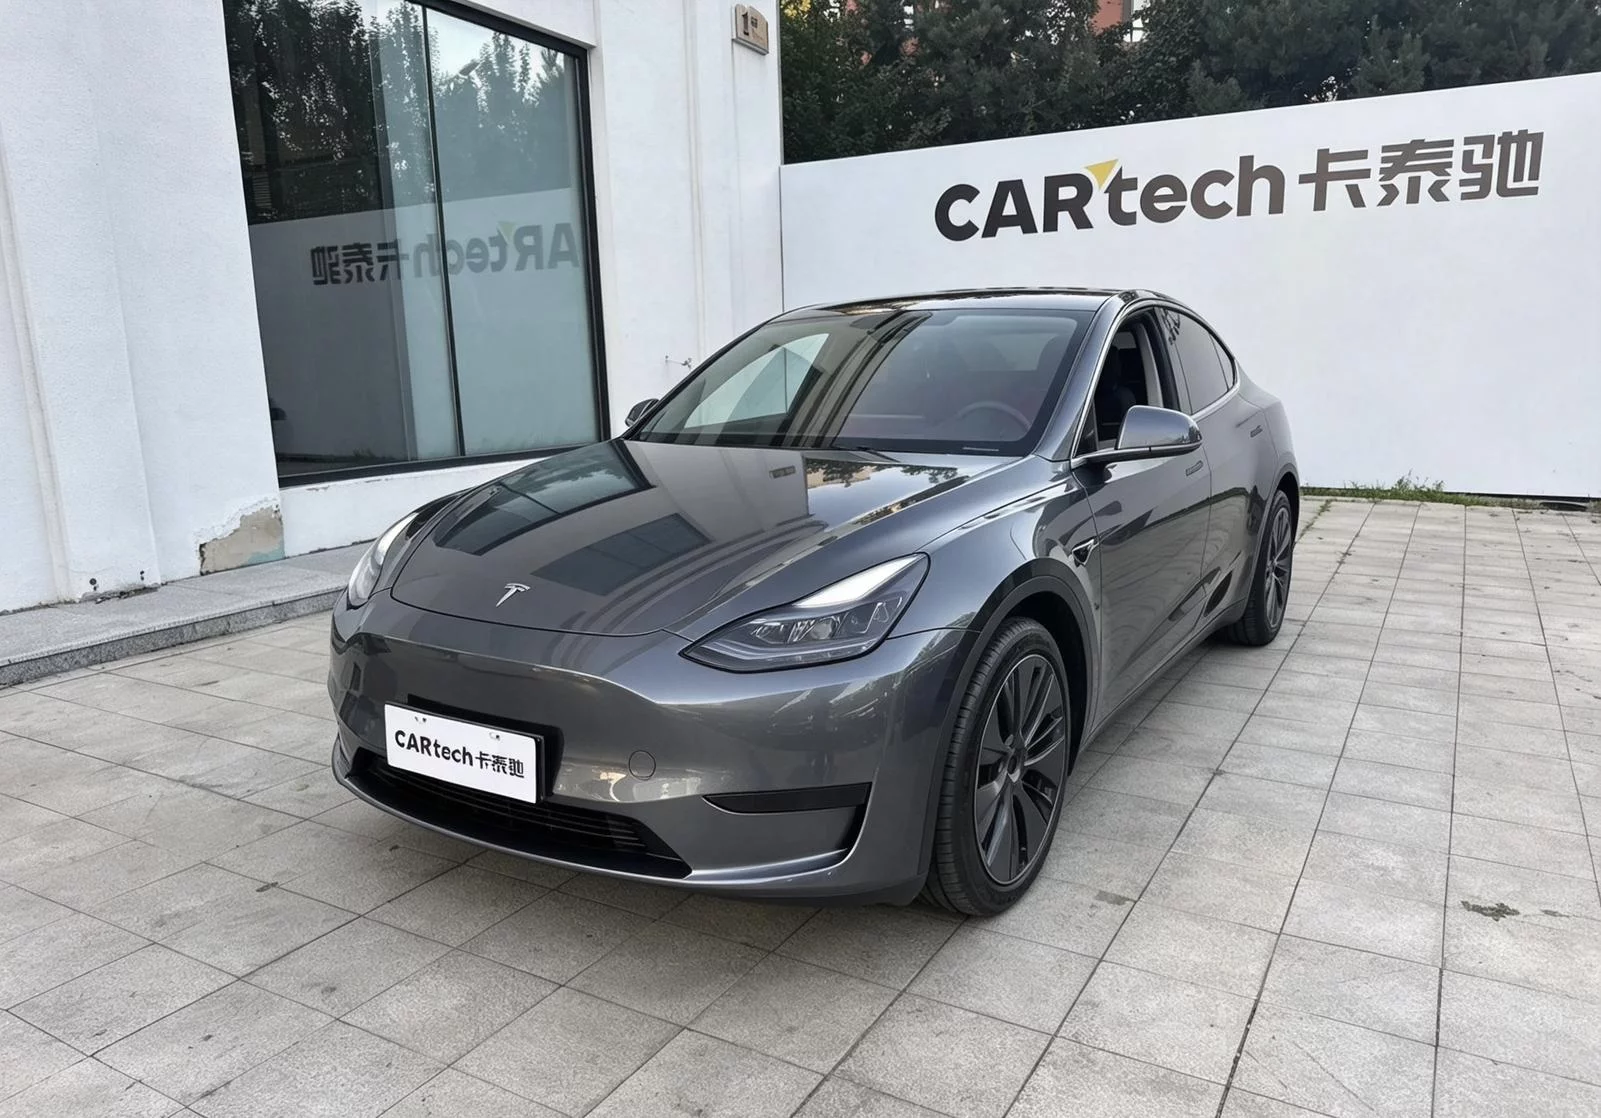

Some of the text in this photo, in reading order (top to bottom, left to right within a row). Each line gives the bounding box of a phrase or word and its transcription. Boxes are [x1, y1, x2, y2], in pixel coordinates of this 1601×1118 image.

[935, 129, 1543, 241] CARtech 卡泰驰
[395, 730, 525, 778] CARtech 卡泰驰
